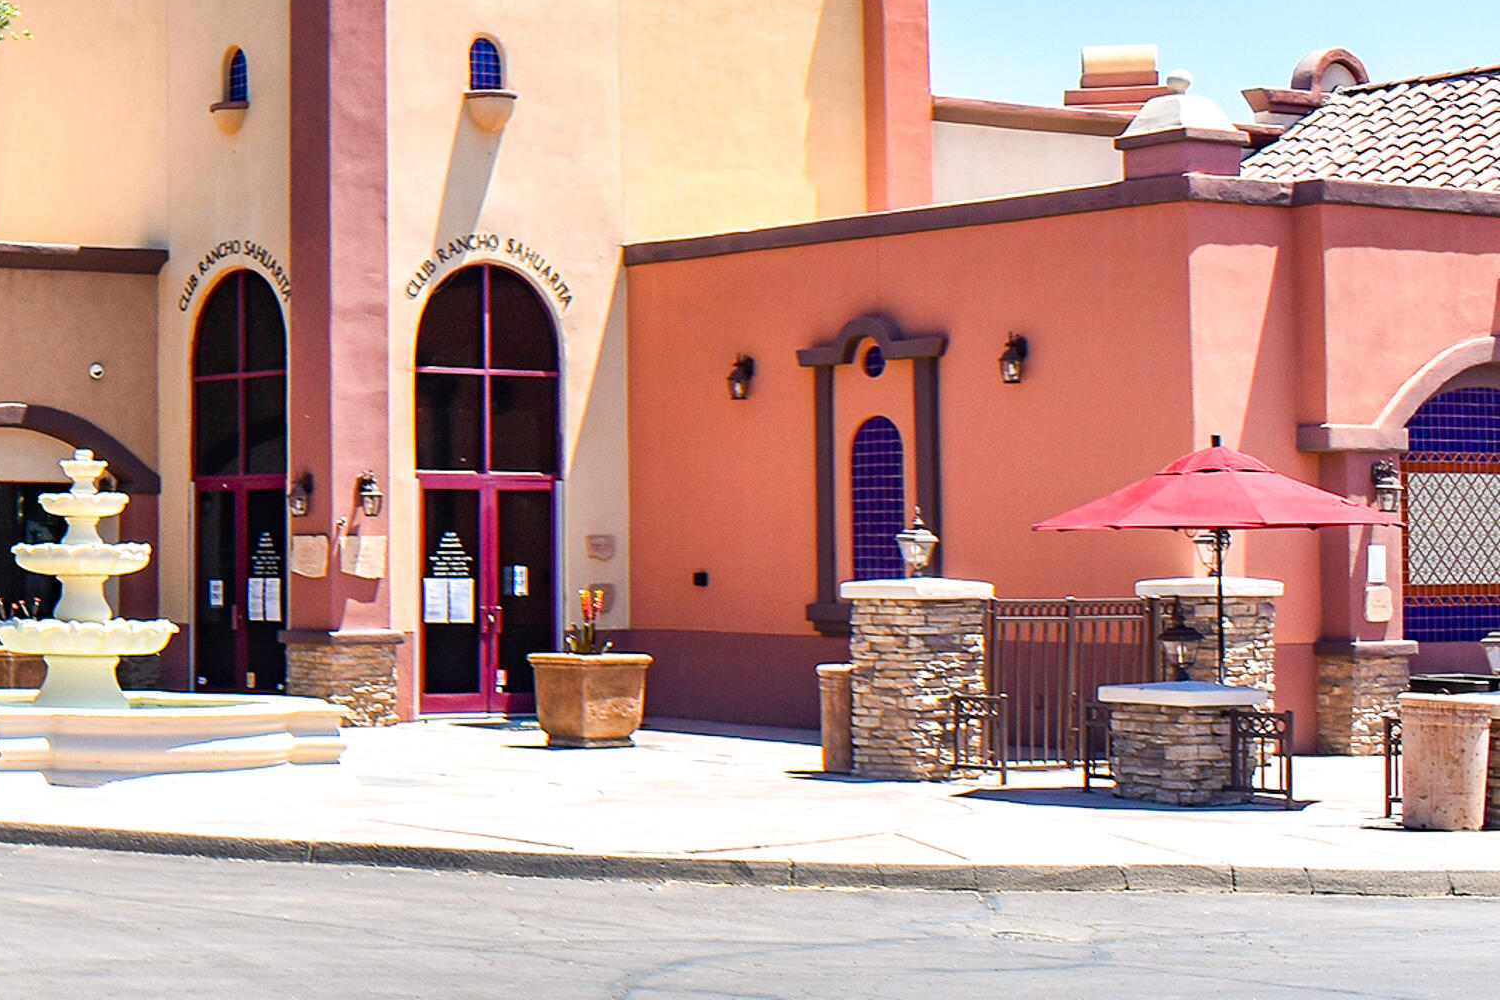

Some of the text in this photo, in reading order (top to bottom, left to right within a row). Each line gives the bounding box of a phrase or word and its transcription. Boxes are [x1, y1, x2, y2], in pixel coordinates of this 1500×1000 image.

[178, 240, 291, 312] CLUB RANCHO SAHUARITA
[405, 234, 573, 311] CLUB RANCHO SAHUARITA
